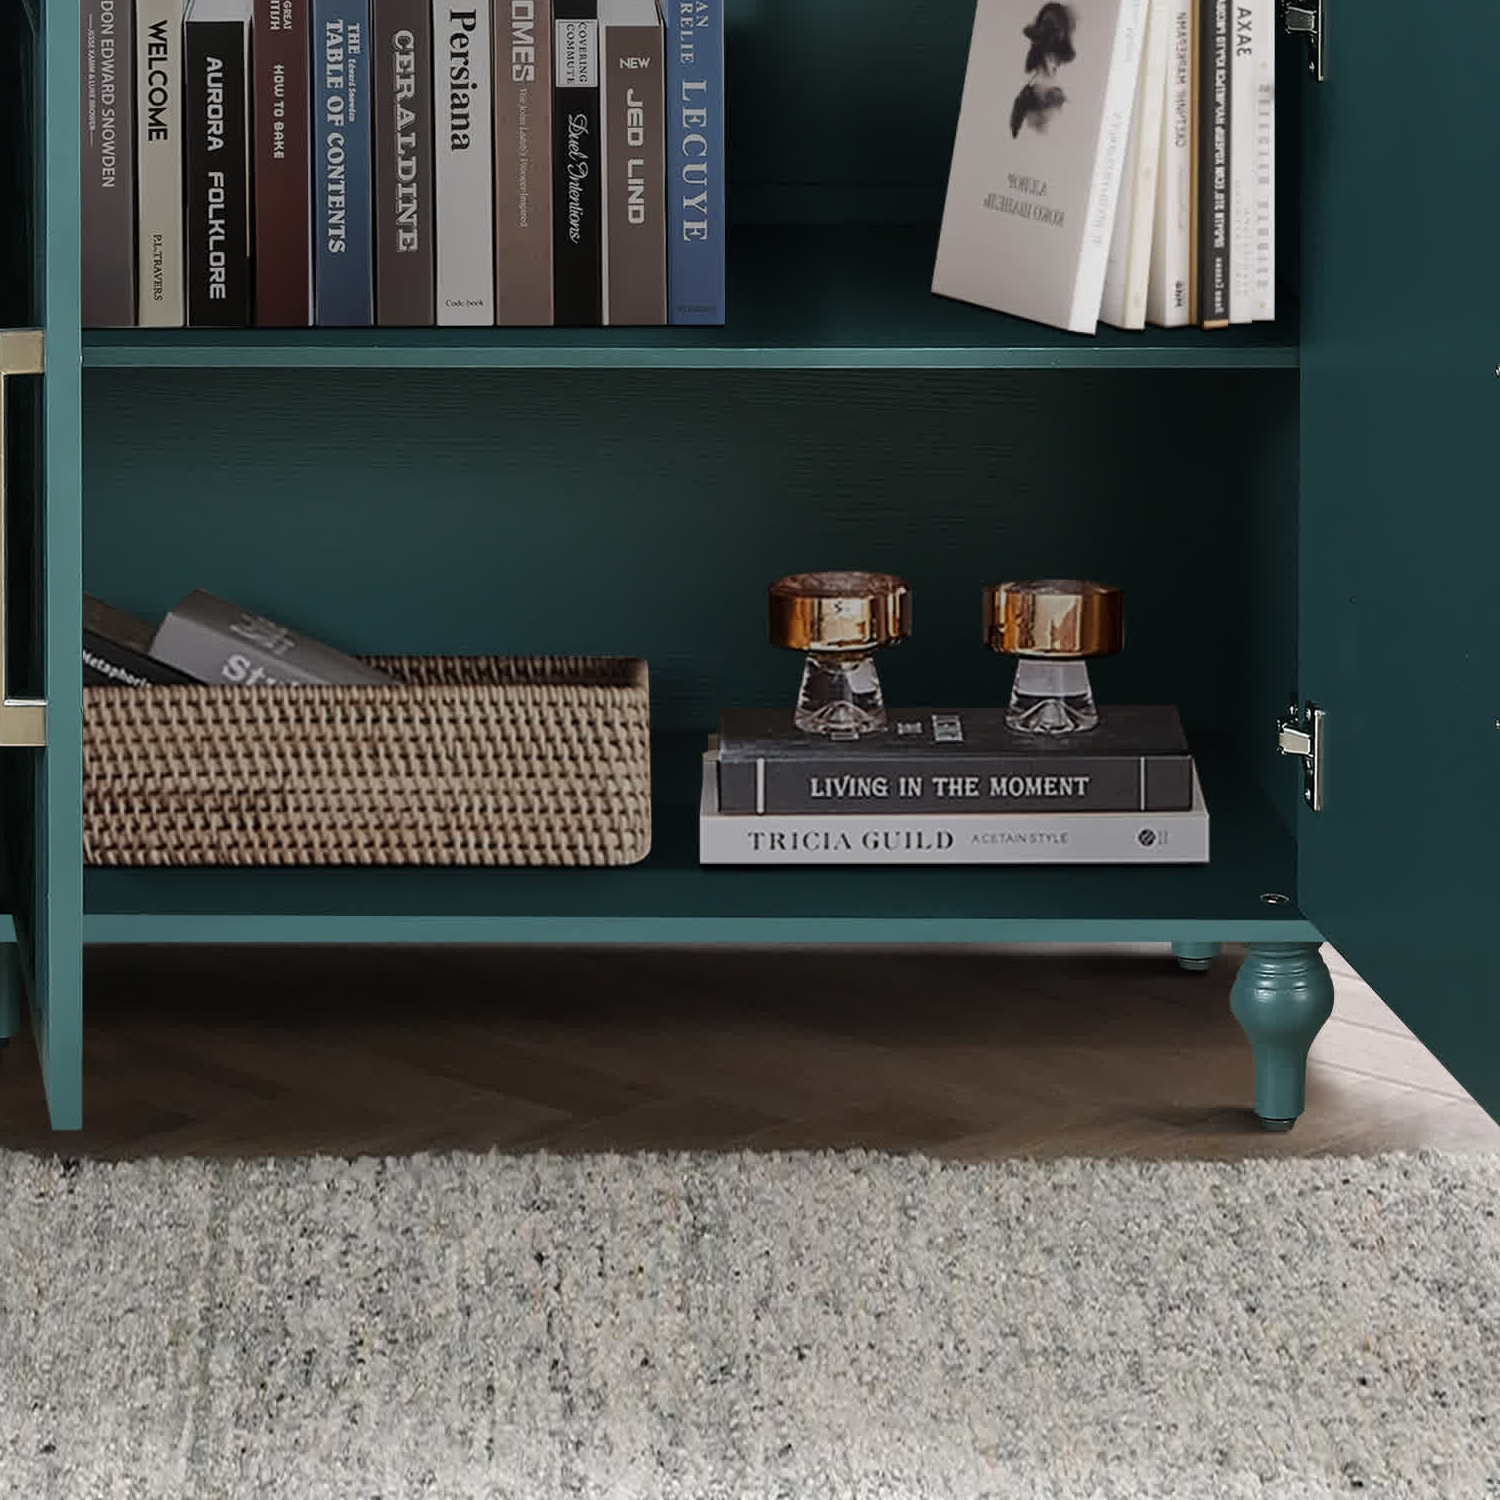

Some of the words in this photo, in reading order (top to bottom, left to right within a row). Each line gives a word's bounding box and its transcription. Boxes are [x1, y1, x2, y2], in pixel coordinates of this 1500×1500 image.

[283, 0, 293, 30] GREAT
[347, 22, 361, 54] THE
[100, 38, 115, 105] EDWARD
[147, 19, 168, 142] WELCOME
[273, 64, 285, 97] HOW
[326, 19, 344, 89] TABLE
[449, 8, 478, 152] Persiana
[566, 23, 575, 85] COMMUTE
[579, 21, 588, 83] COVERING
[619, 57, 651, 69] NEW
[206, 56, 224, 152] AURORA
[274, 100, 285, 117] TO
[326, 95, 345, 127] OF
[626, 88, 645, 147] JED
[101, 108, 116, 188] SNOWDEN
[273, 121, 285, 159] BAKE
[682, 79, 709, 242] LECUYE
[327, 132, 346, 253] CONTENTS
[627, 158, 646, 224] LIND
[208, 171, 226, 299] FOLKLORE
[810, 776, 889, 798] LIVING
[899, 776, 922, 797] IN
[931, 776, 979, 797] THE
[989, 776, 1090, 797] MOMENT
[747, 831, 853, 851] TRICIA
[861, 830, 955, 850] GUILD
